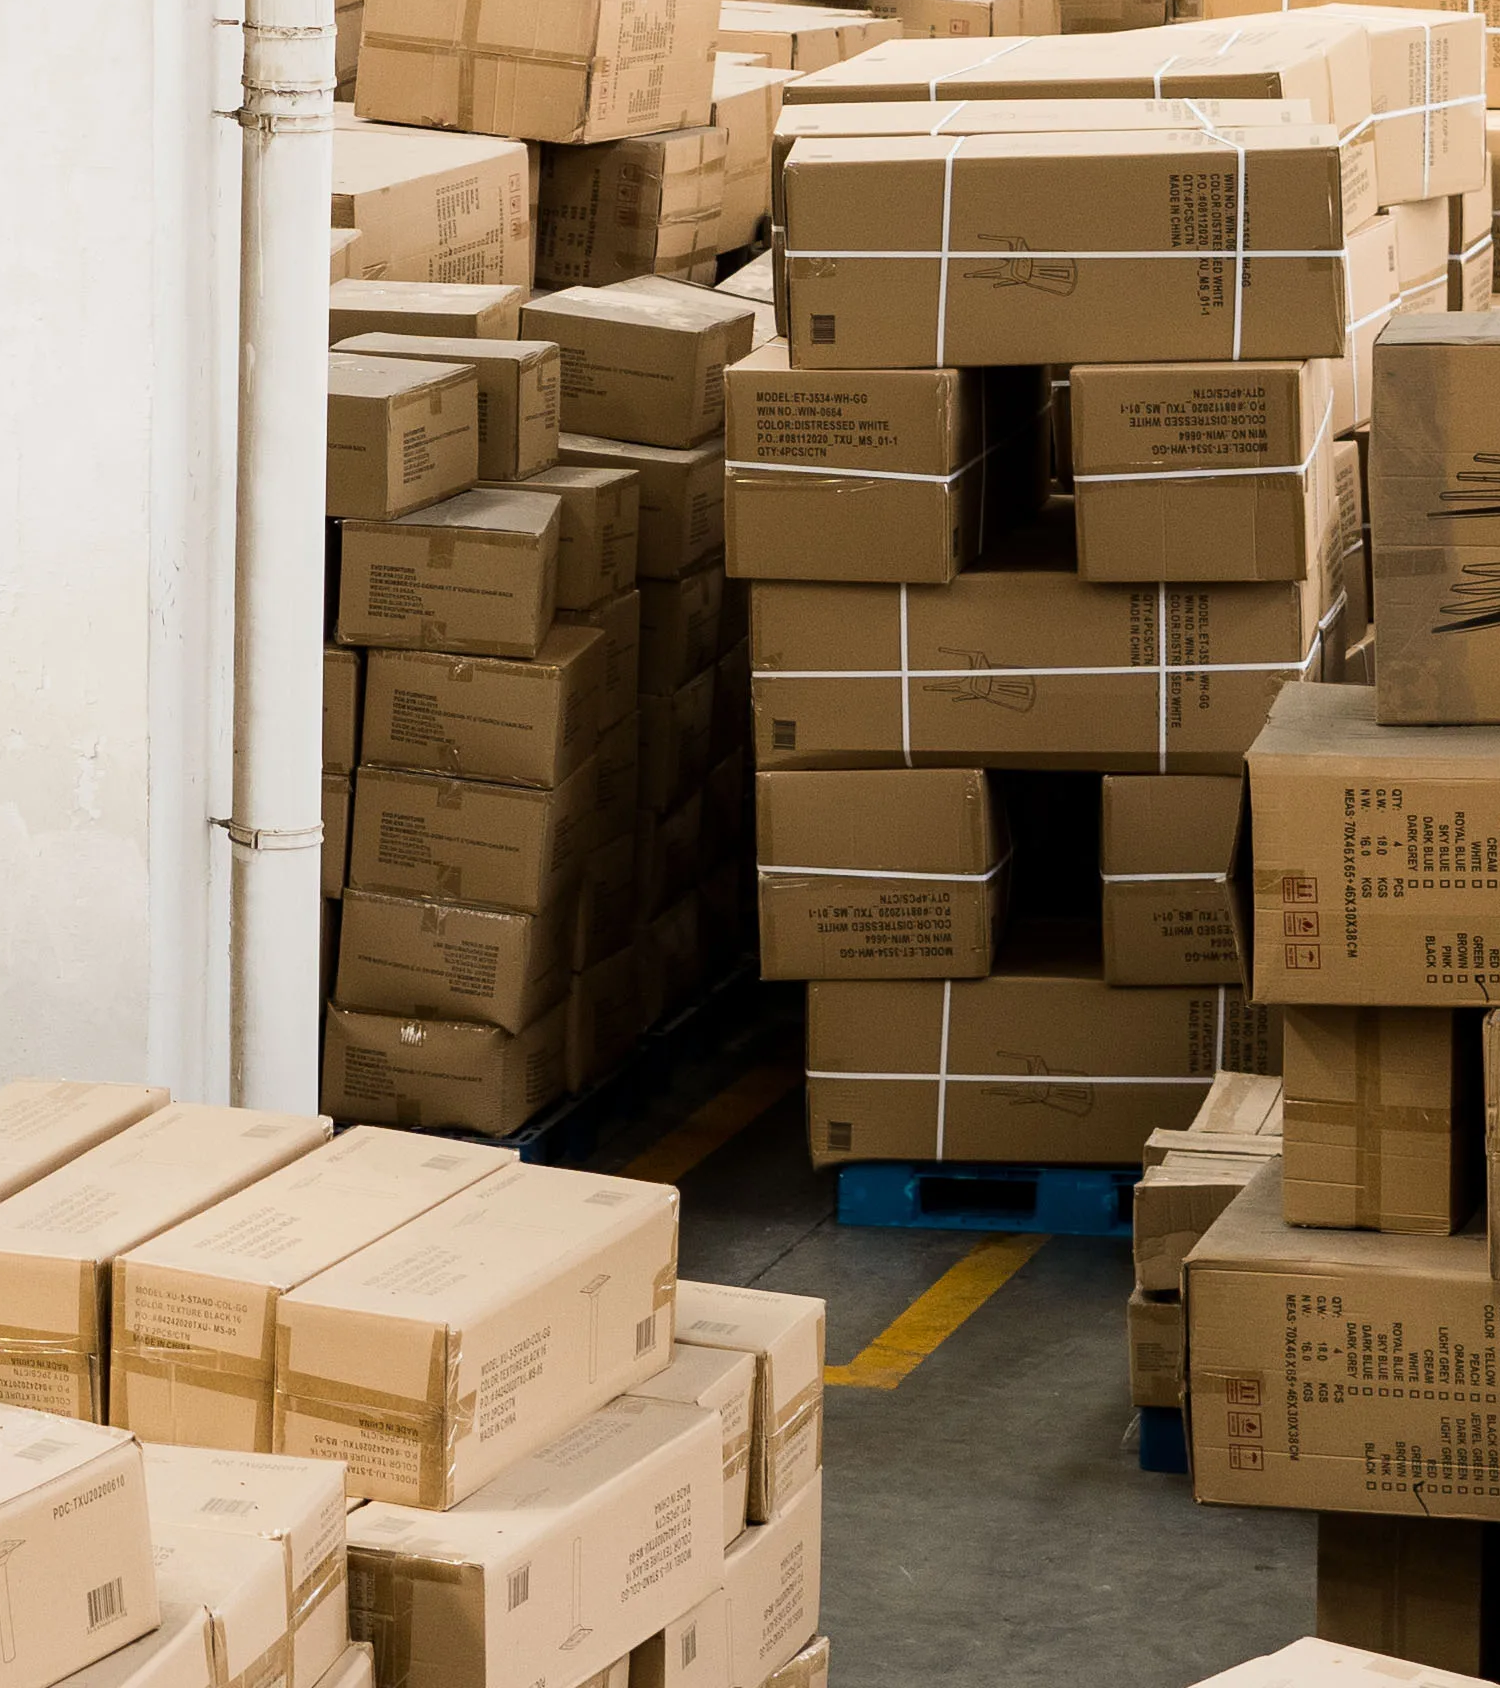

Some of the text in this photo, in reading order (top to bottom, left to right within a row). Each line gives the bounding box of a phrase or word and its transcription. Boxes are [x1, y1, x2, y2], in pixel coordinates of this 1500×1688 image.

[1224, 174, 1234, 192] WIN
[1170, 175, 1181, 247] MADE IN CHINA
[757, 392, 867, 404] MODEL:ET-3534-WH-GG
[757, 407, 775, 416] WIN
[757, 420, 889, 431] COLOR:DISTRESSED WHITE
[758, 447, 826, 457] QTY:4PCS/CTN
[1392, 789, 1402, 811] QTY:
[1407, 815, 1418, 872] DARK GREY
[1423, 817, 1433, 872] DARK BLUE
[1439, 825, 1450, 872] SKY BLUE
[1455, 812, 1466, 872] ROYAL BLUE
[1471, 841, 1481, 872] WHITE
[1487, 837, 1497, 872] CREAM
[1361, 877, 1372, 898] KGS
[1377, 877, 1388, 898] KGS
[1393, 878, 1403, 897] PCS
[1426, 936, 1436, 968] BLACK
[1442, 946, 1451, 968] PINK
[1457, 933, 1468, 969] BROWN
[1473, 936, 1483, 968] GREEN
[1489, 949, 1499, 968] RED
